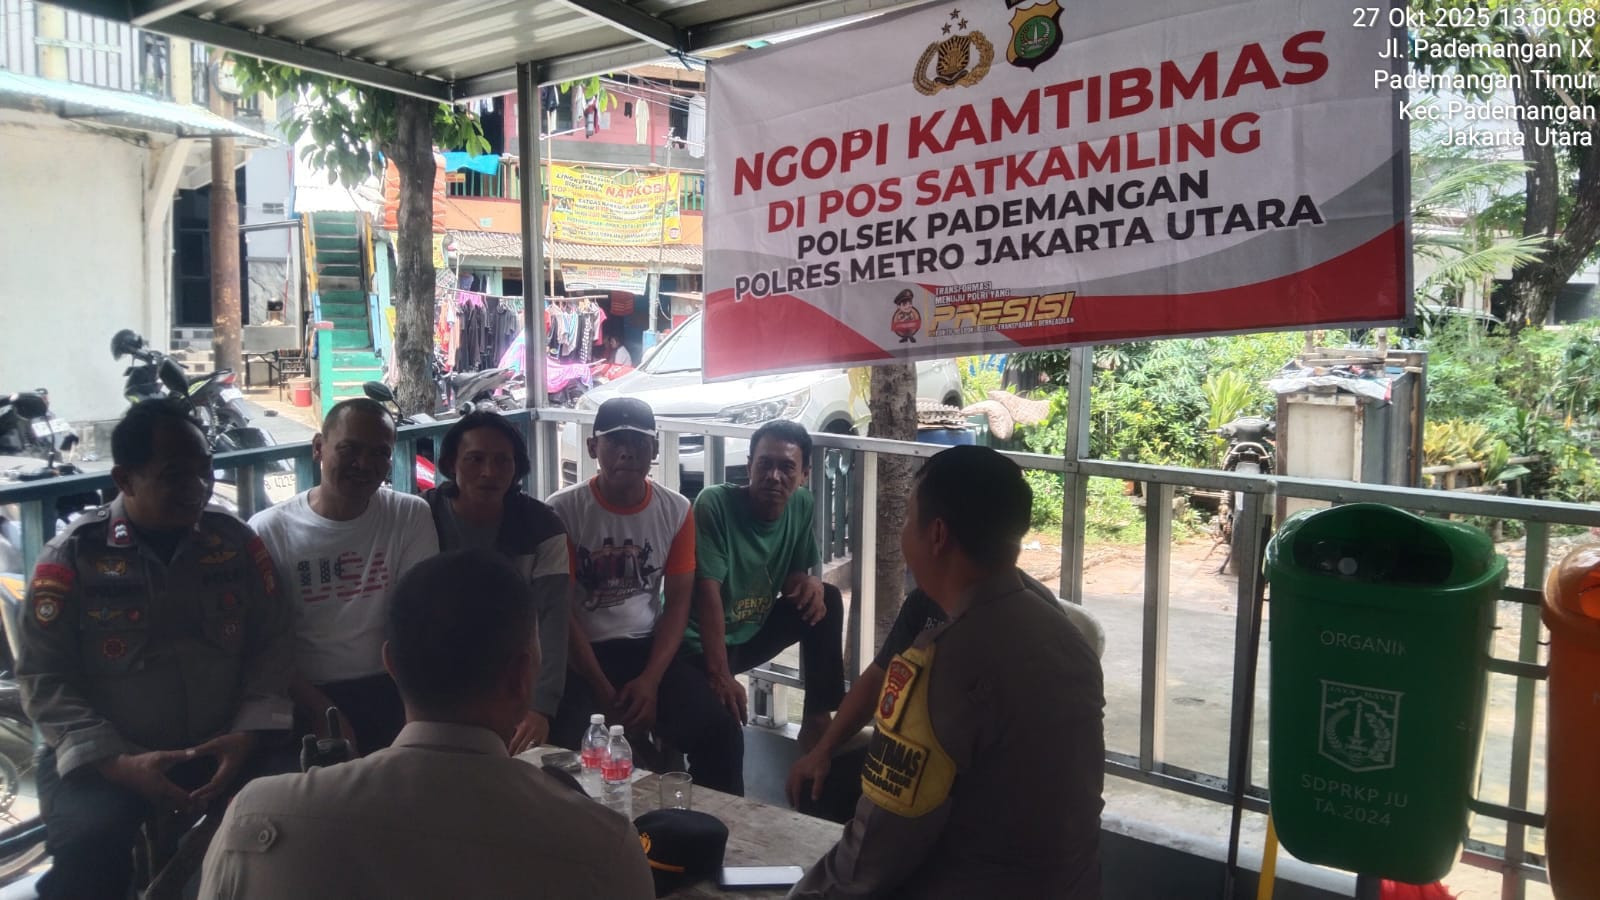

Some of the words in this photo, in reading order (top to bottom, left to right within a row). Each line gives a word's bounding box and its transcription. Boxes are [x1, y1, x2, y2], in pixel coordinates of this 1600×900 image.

[733, 123, 889, 196] NGOPI
[907, 30, 1329, 159] KAMTIBMAS
[605, 183, 672, 199] NARKOBA
[768, 196, 805, 233] DI
[818, 177, 903, 224] POS
[915, 112, 1261, 206] SATKAMLING
[797, 216, 918, 260] POLSEK
[927, 169, 1209, 239] PADEMANGAN
[735, 261, 841, 300] POLRES
[850, 243, 964, 283] METRO
[974, 216, 1154, 266] JAKARTA
[1167, 194, 1325, 240] UTARA
[935, 281, 992, 295] TRANSFORMASI
[935, 294, 965, 305] MENUJU
[967, 291, 988, 302] POLRI
[990, 288, 1010, 299] YANG
[928, 291, 1076, 337] PRESISI
[1301, 773, 1379, 804] SDPRKP
[1384, 791, 1407, 808] JU
[1313, 798, 1392, 826] TA.2024
